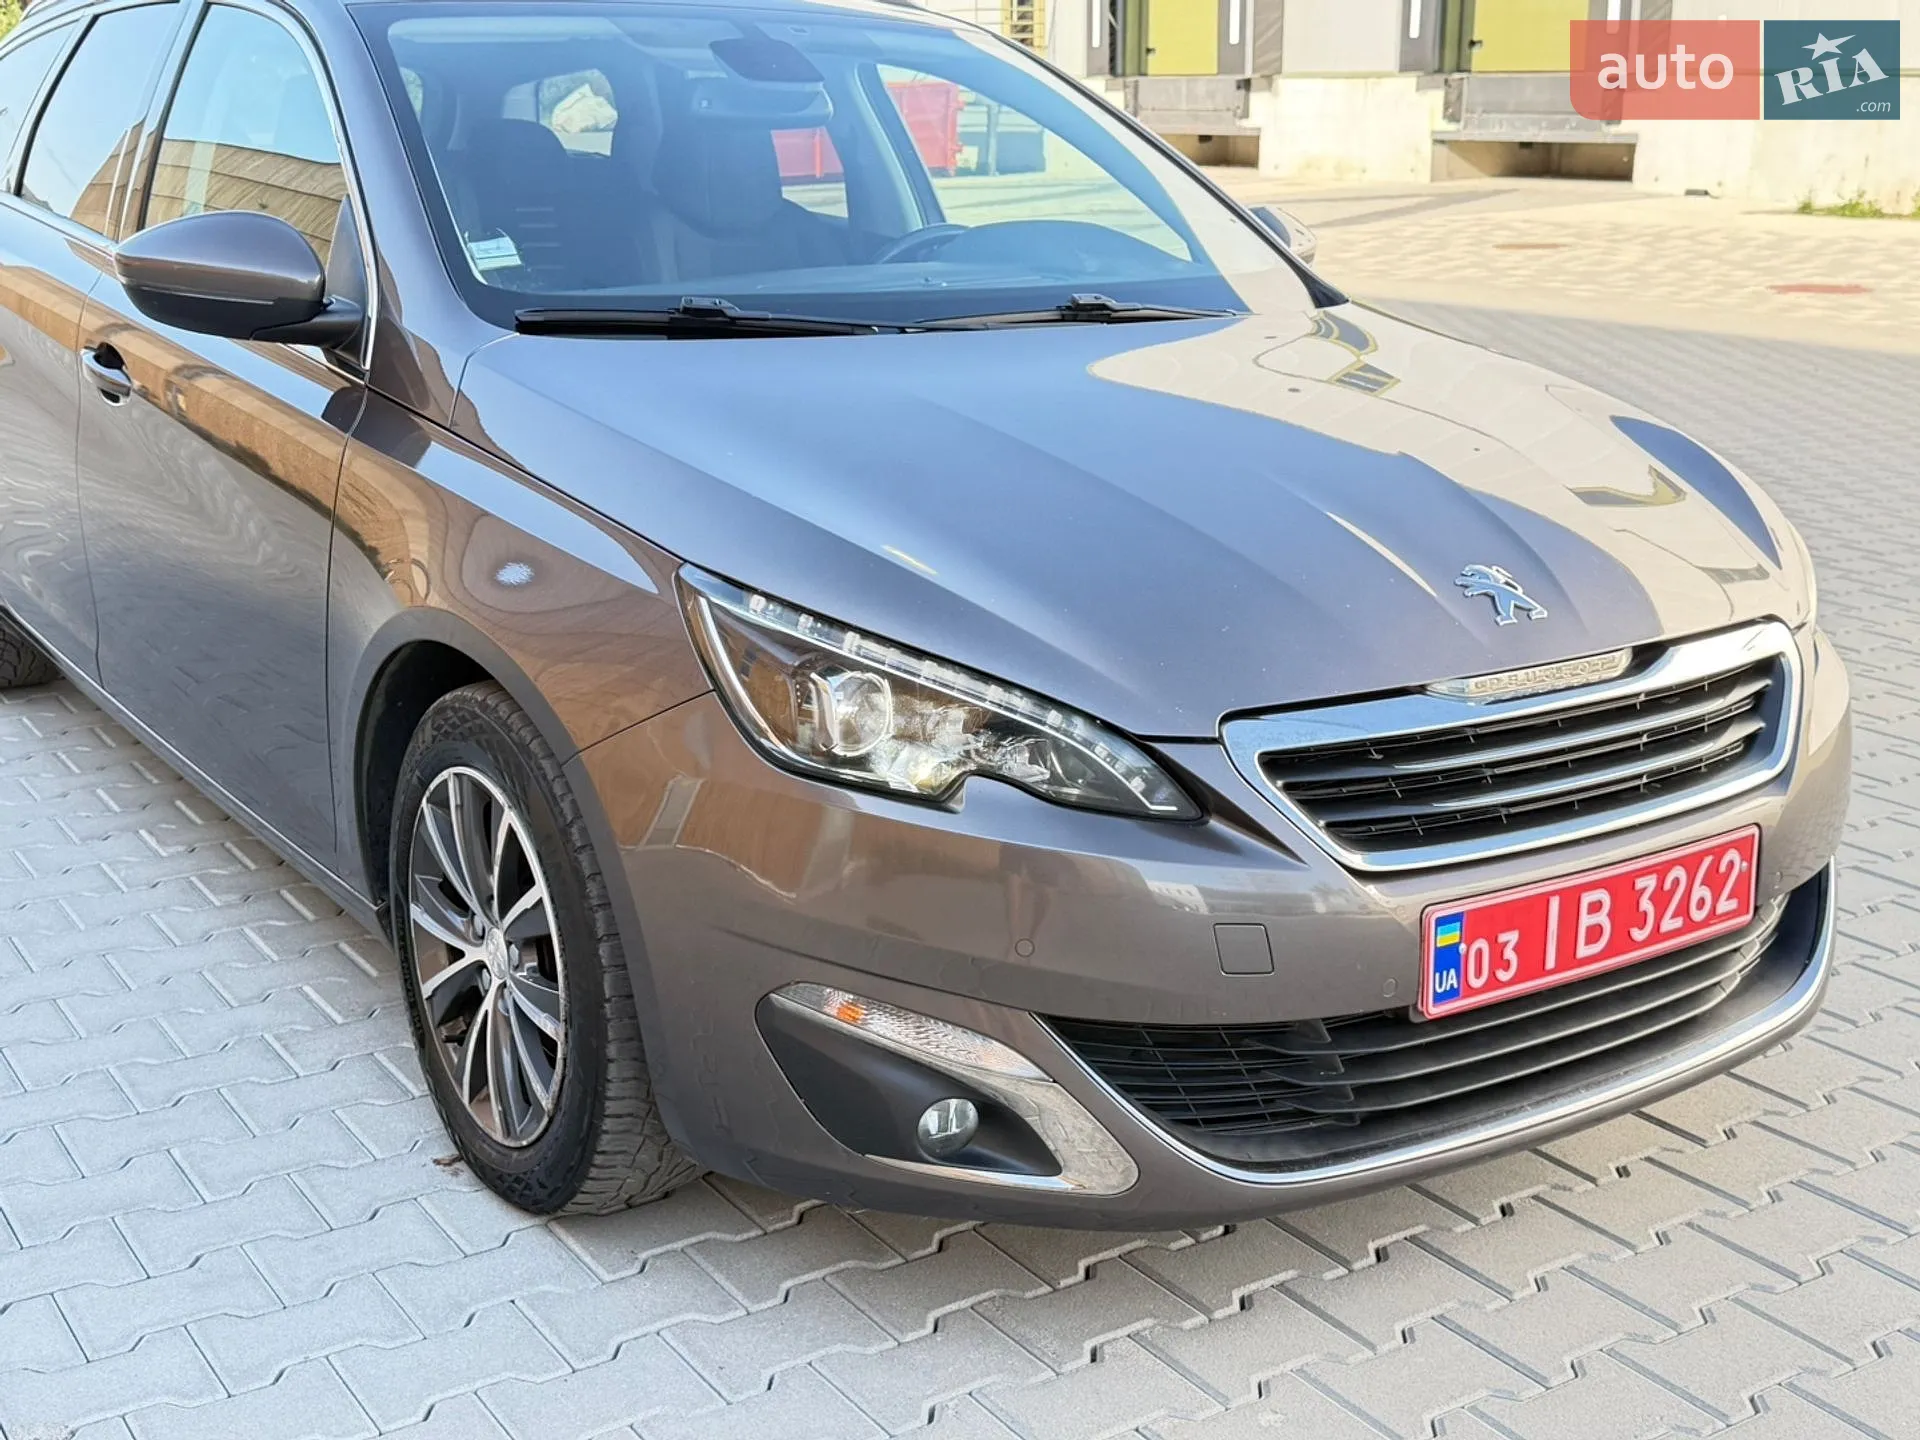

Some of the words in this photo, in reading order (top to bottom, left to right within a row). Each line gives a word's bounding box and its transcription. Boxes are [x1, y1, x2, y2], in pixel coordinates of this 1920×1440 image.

[1467, 929, 1520, 989] 03
[1544, 887, 1612, 971] IB
[1629, 848, 1742, 942] 3262
[1435, 968, 1458, 993] UA
